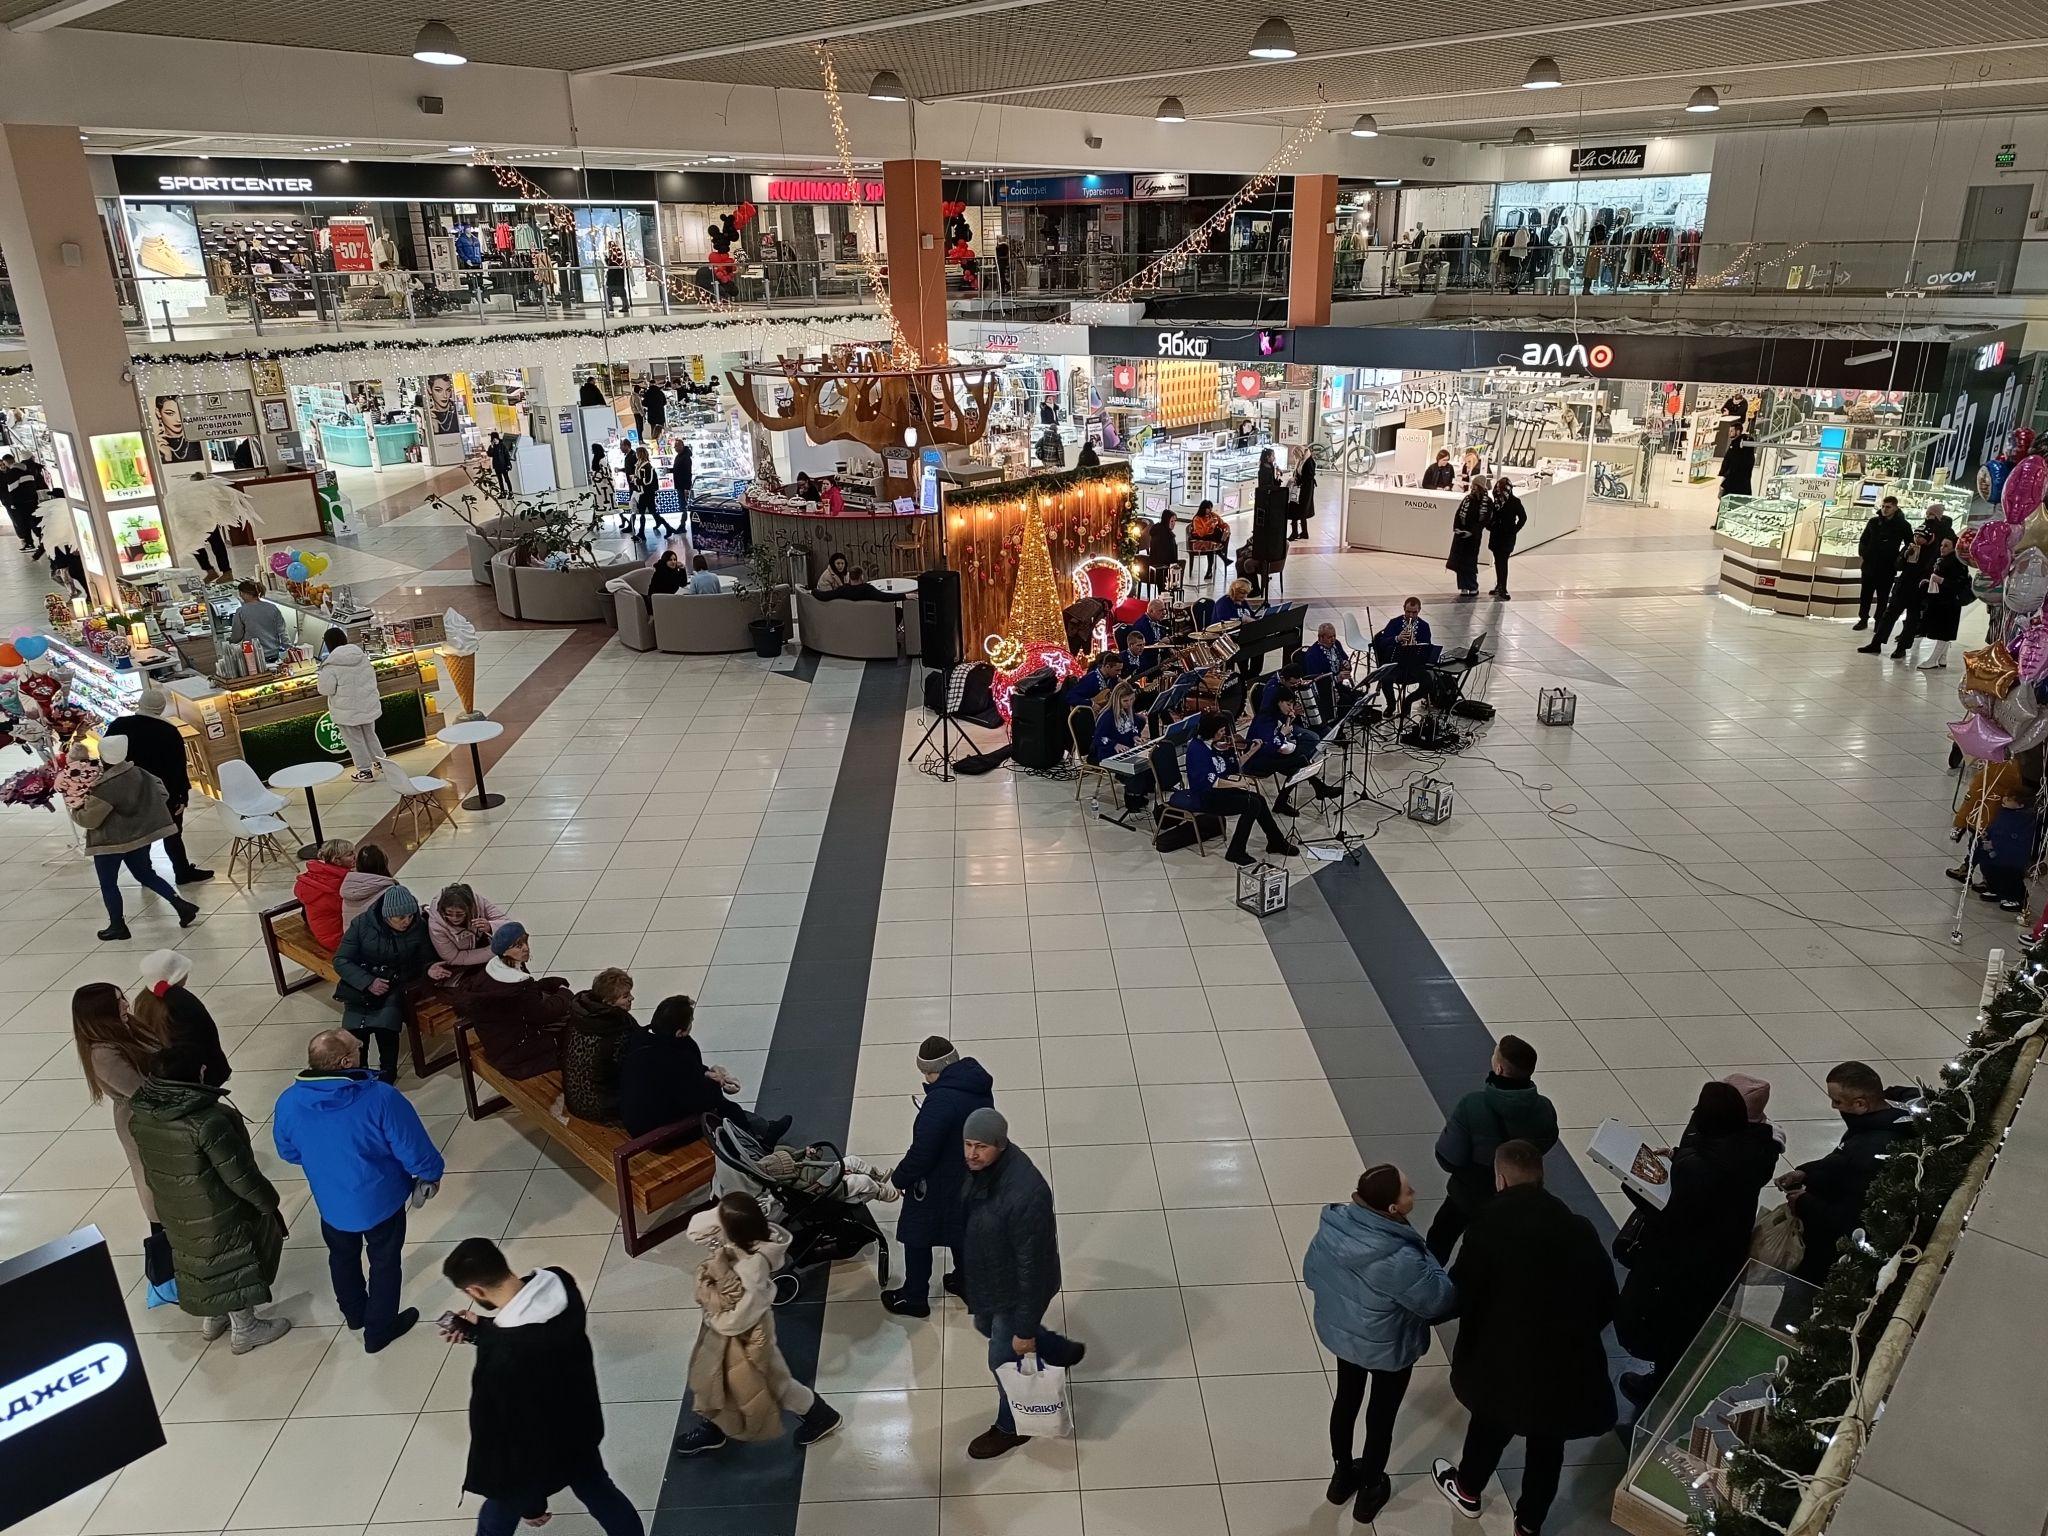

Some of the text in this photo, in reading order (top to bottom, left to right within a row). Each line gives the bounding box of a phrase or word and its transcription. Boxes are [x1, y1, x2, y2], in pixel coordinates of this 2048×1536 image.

[1598, 148, 1642, 166] Milla
[158, 176, 313, 191] SPORTCENTER
[1082, 187, 1124, 198] Турагентство
[1158, 331, 1209, 357] Ябко
[1382, 387, 1462, 407] PANDORA
[197, 420, 243, 430] ДОВІДКОВА
[205, 428, 239, 437] СЛУЖБА
[1404, 500, 1437, 509] PANDORA
[320, 720, 340, 732] Fre
[330, 730, 344, 742] Be
